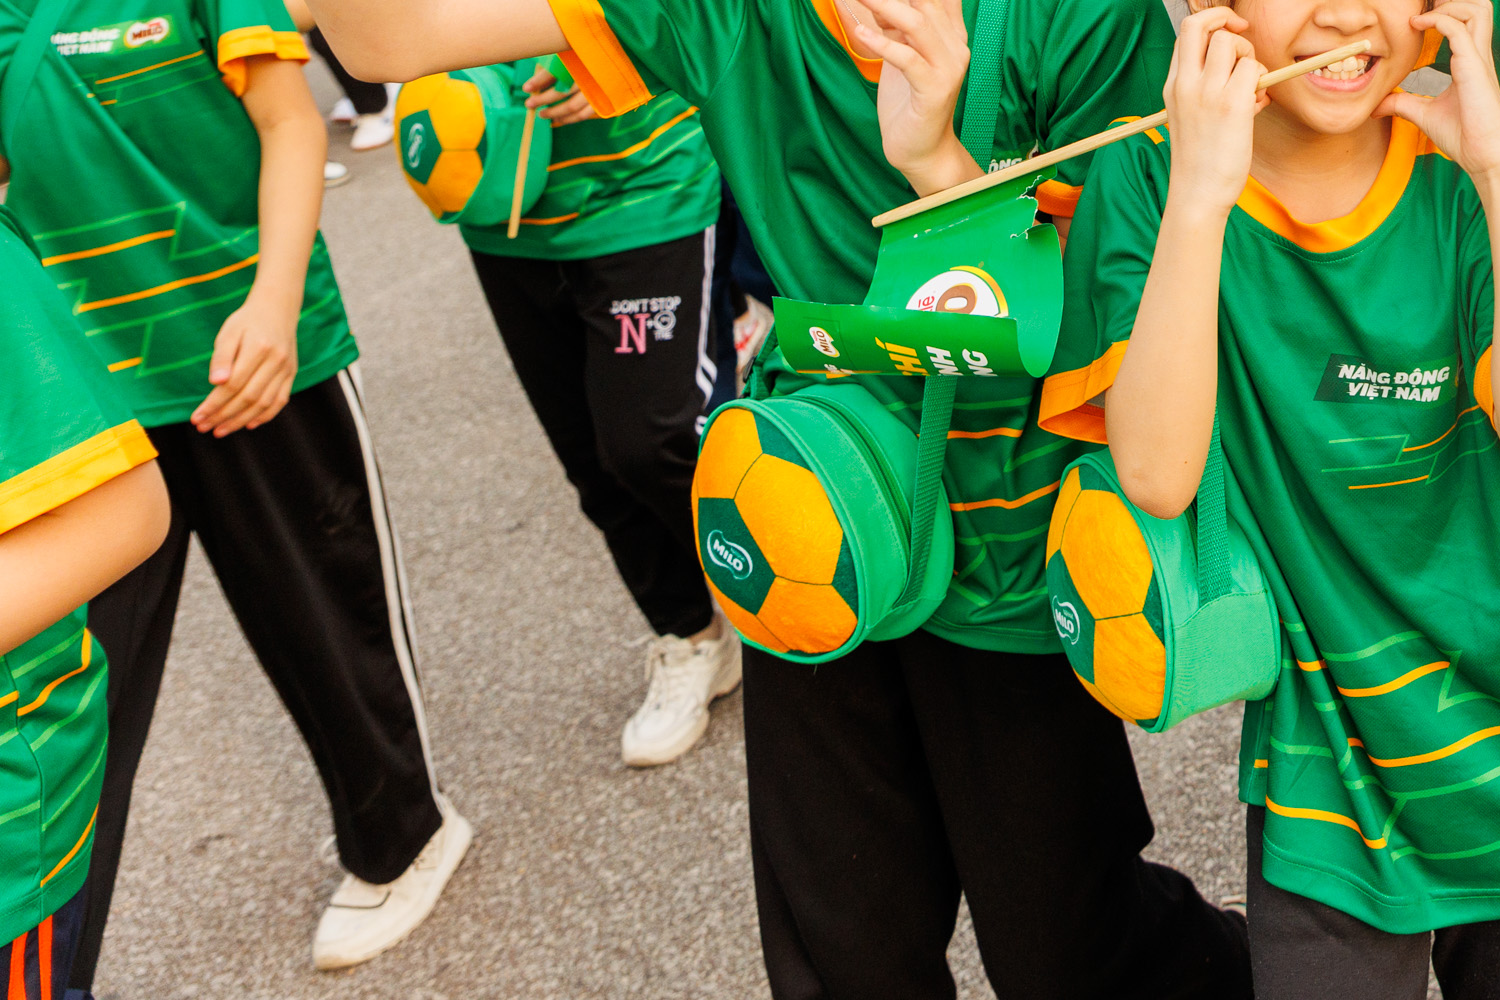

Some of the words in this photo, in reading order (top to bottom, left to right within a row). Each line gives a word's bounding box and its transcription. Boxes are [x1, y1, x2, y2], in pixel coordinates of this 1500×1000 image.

[649, 295, 682, 312] STOP
[614, 312, 651, 355] N
[816, 330, 833, 354] MILO
[875, 337, 930, 376] HÍ
[1337, 363, 1391, 384] NĂNG
[1394, 366, 1450, 388] ĐỘNG
[1346, 382, 1393, 400] VIỆT
[1393, 386, 1441, 402] NAM
[713, 539, 744, 571] MILO
[1055, 608, 1075, 634] MILO
